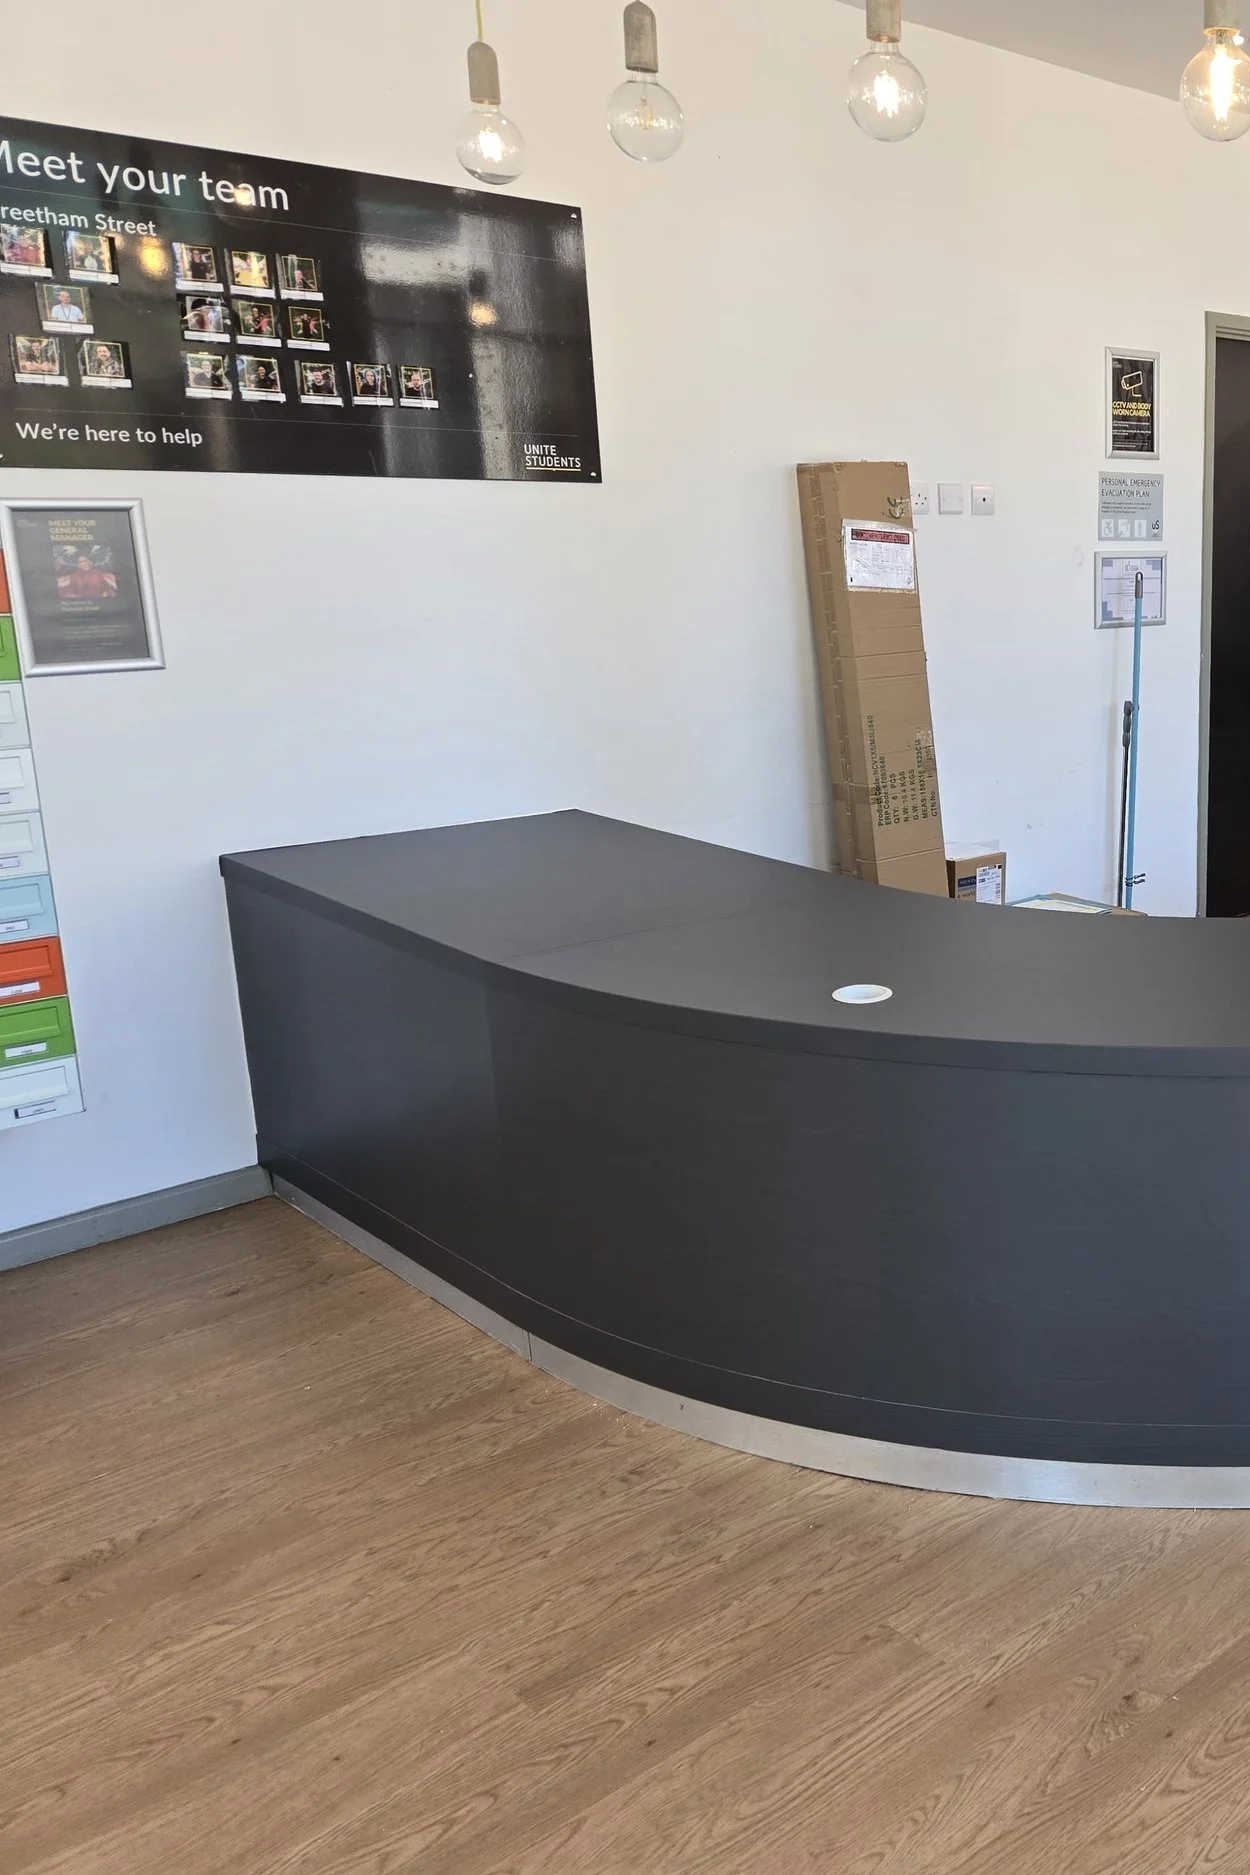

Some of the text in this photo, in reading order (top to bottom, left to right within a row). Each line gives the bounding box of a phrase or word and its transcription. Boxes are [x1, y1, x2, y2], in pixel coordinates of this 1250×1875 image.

[97, 161, 187, 196] your
[198, 170, 290, 211] team
[0, 205, 157, 237] reetham Street
[1112, 401, 1126, 409] CCTV
[1127, 402, 1137, 410] AND
[1129, 409, 1151, 417] CAMERA
[15, 421, 203, 448] We’re here to help
[523, 443, 557, 456] UNITE
[525, 455, 581, 468] STUDENTS
[1101, 477, 1161, 488] PERSONAL EMERGENCY
[1101, 488, 1150, 498] EVACUATION PLAN
[876, 796, 884, 826] Product
